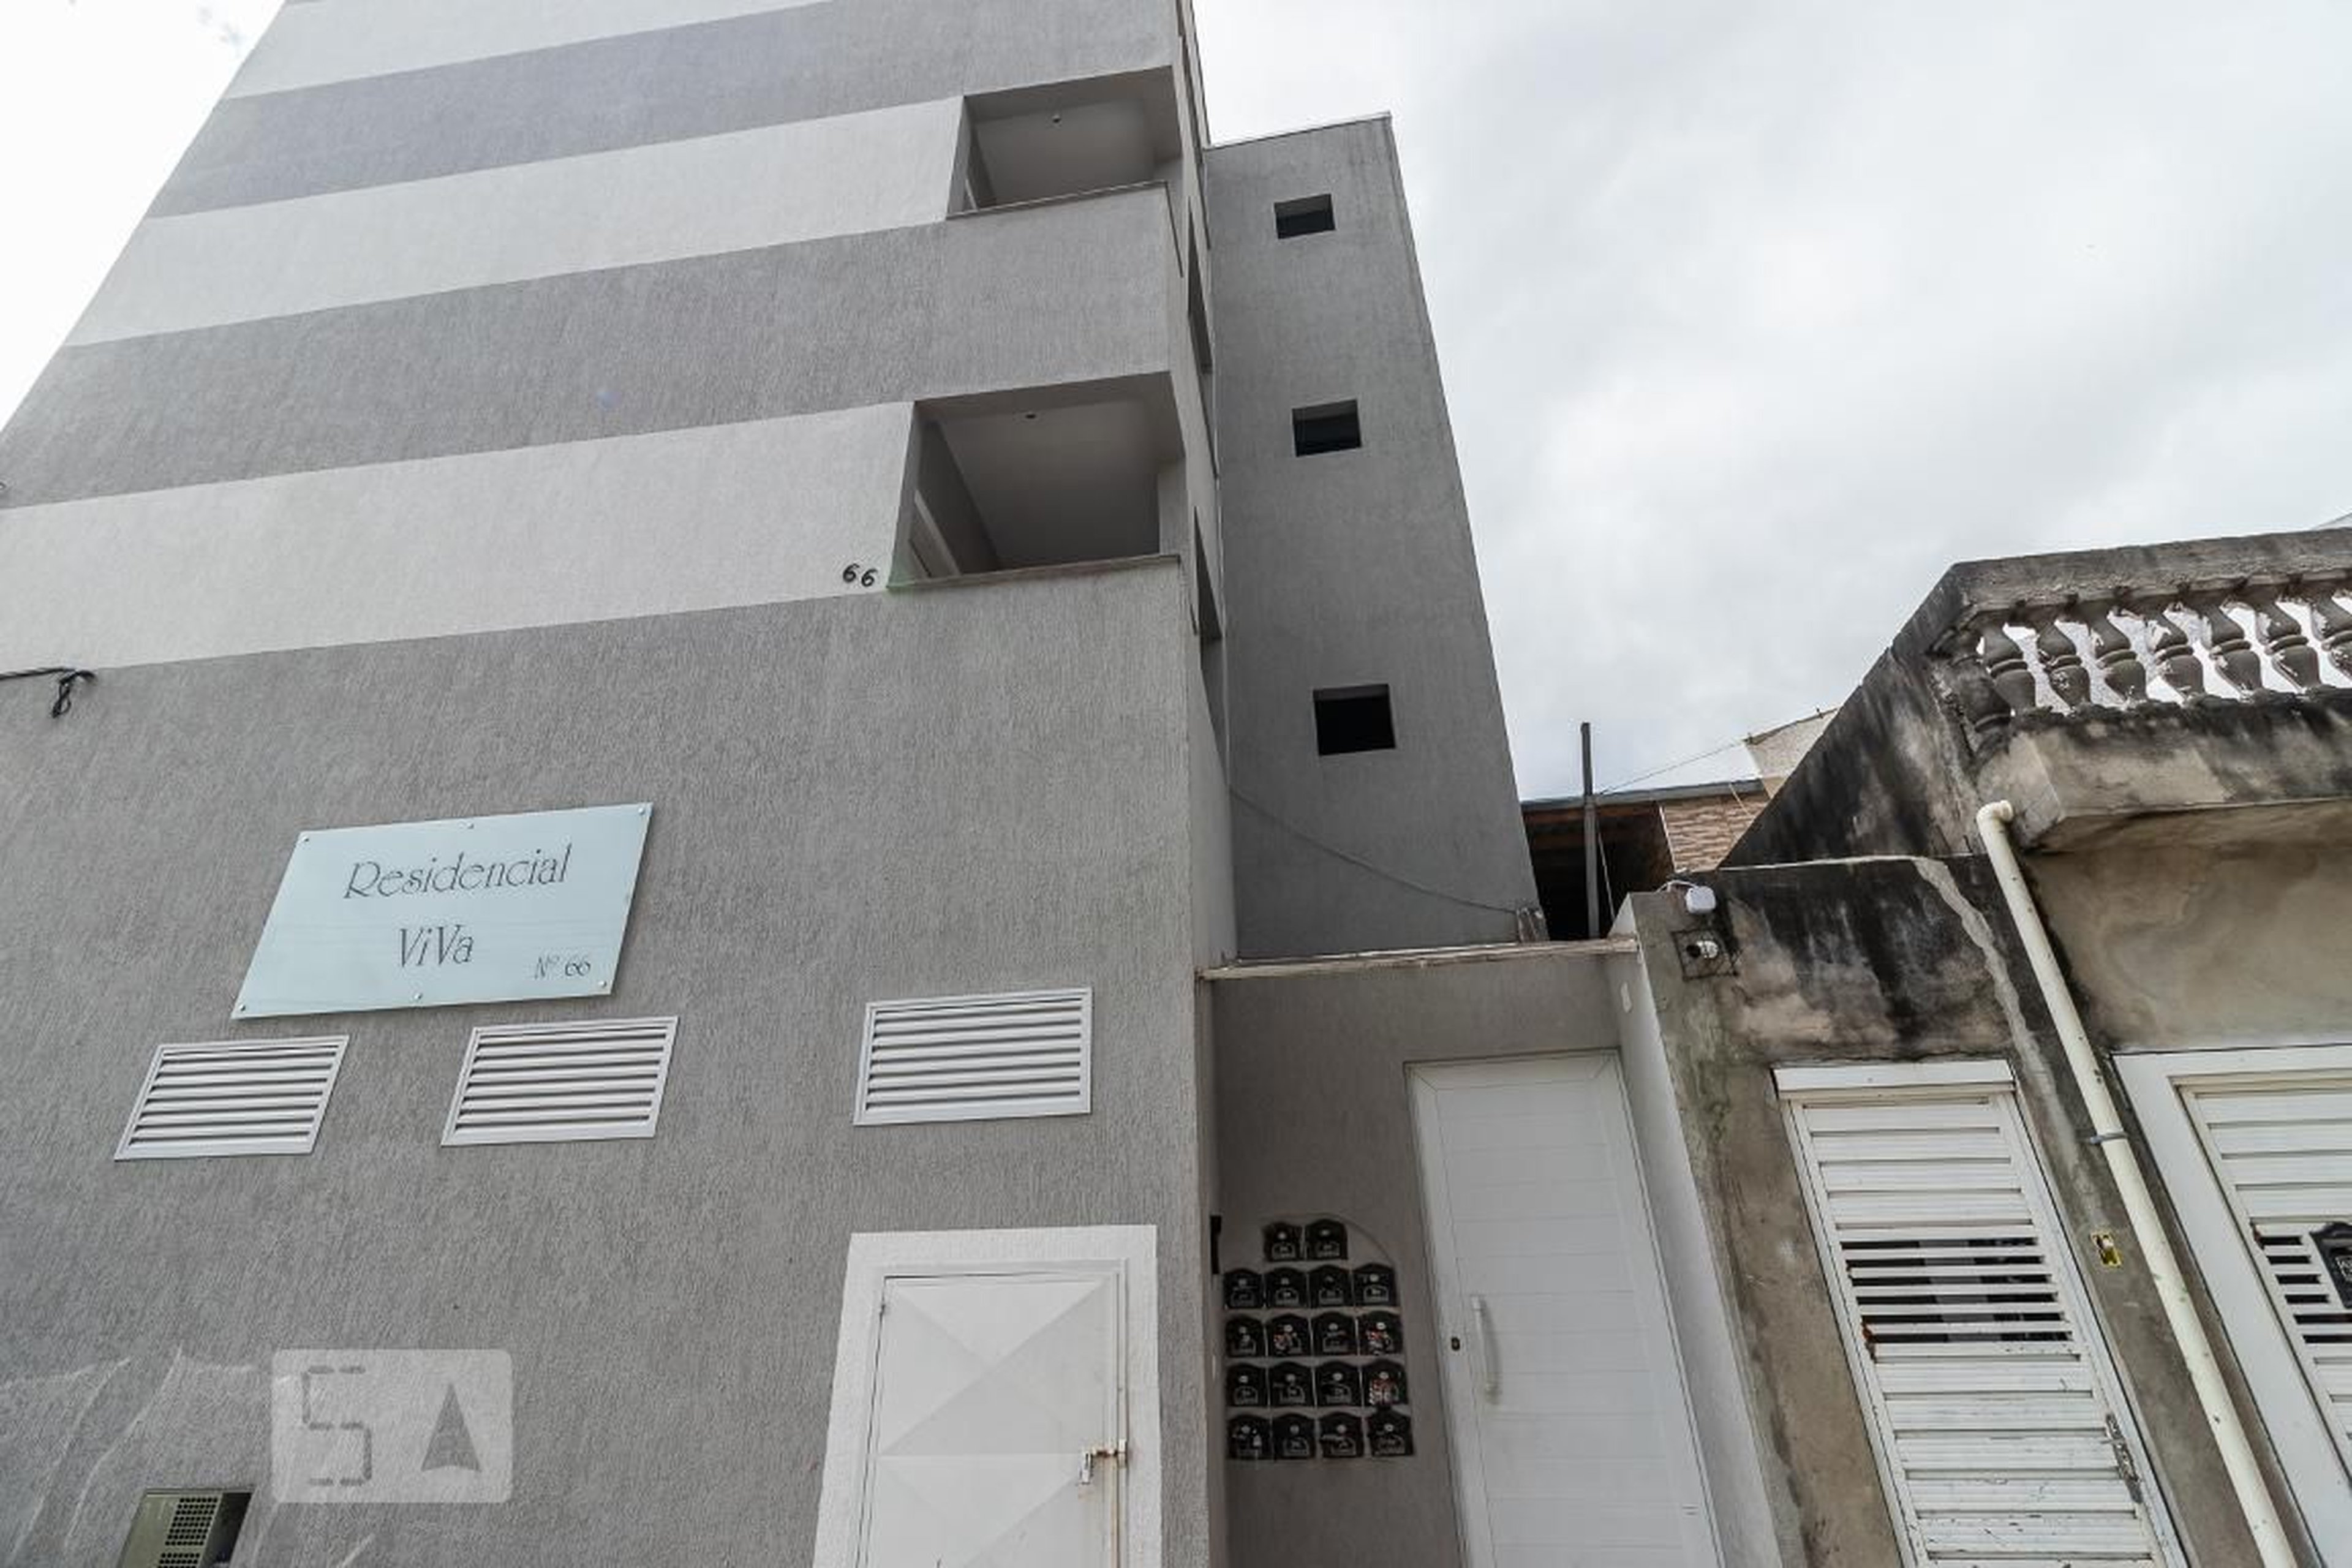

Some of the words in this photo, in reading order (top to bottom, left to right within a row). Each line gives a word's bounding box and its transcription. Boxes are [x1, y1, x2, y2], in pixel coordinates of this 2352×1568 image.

[843, 563, 878, 587] 66
[344, 842, 572, 899] Residencial
[400, 924, 474, 967] ViVa
